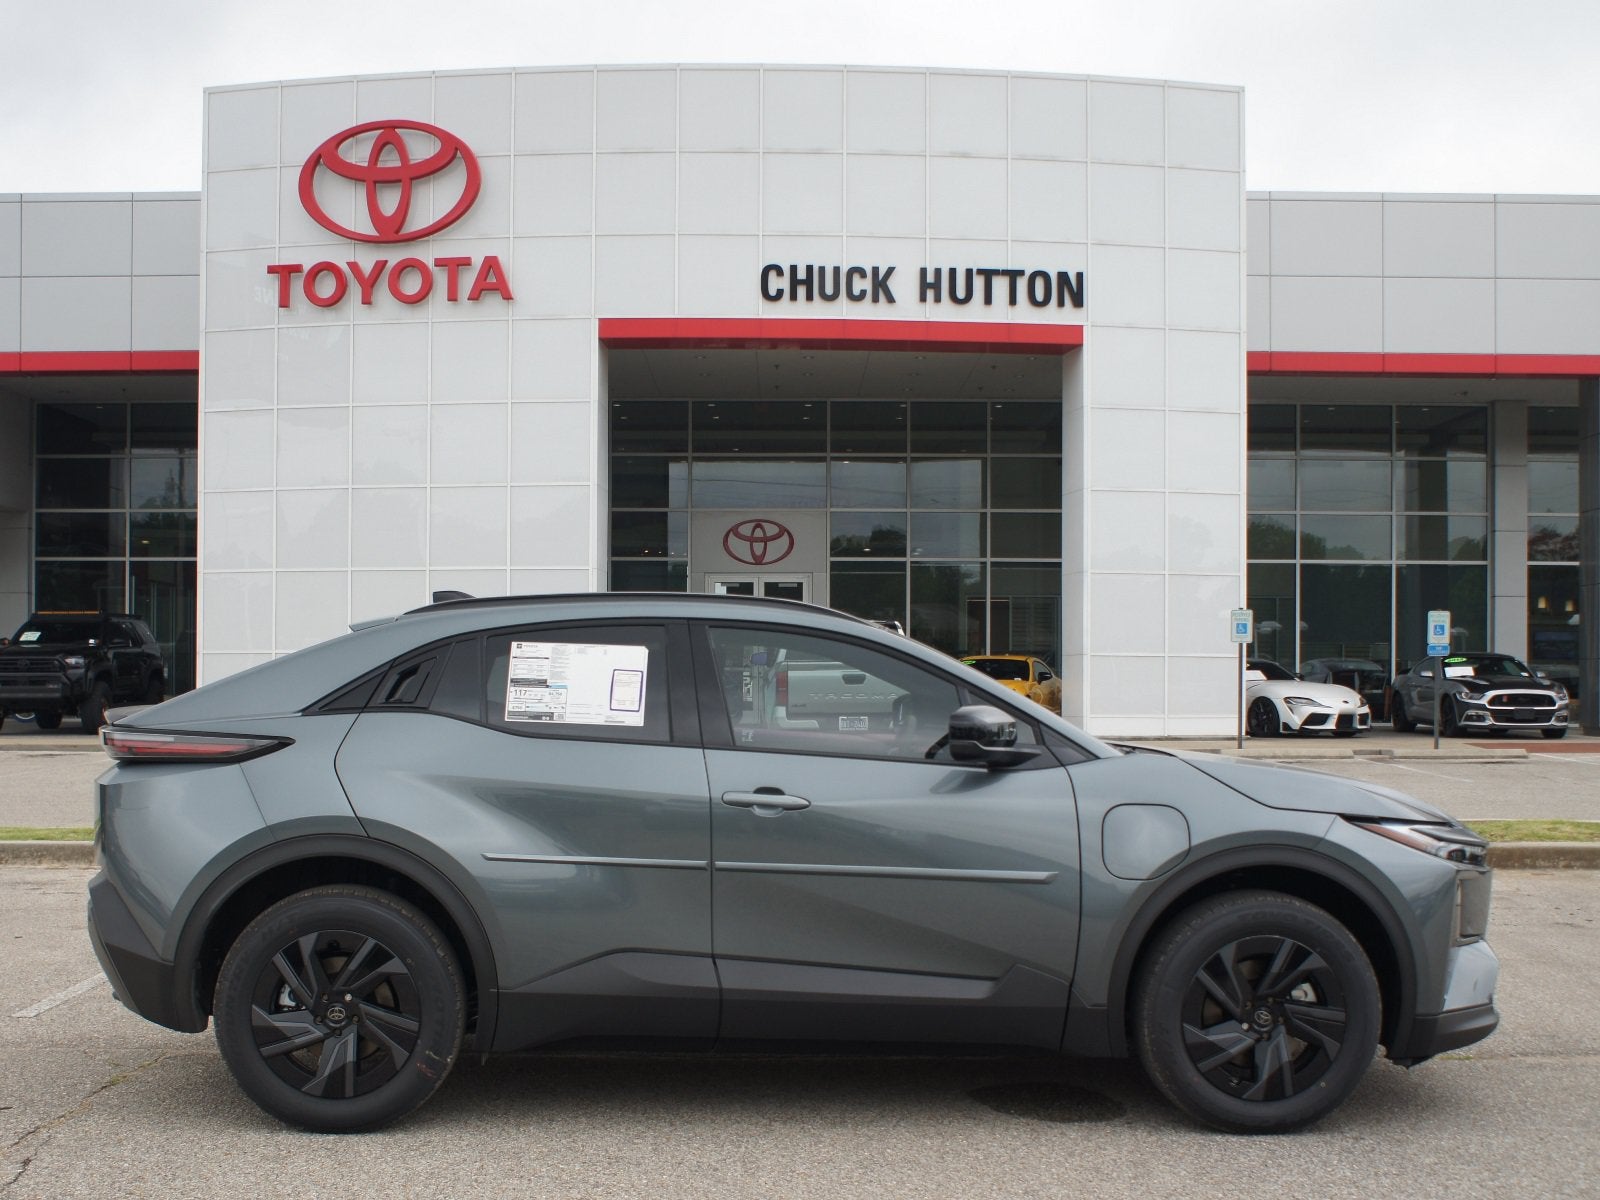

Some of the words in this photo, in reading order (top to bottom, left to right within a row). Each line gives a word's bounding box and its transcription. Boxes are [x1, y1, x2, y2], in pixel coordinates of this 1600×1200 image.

[267, 255, 514, 308] TOYOTA
[760, 263, 897, 304] CHUCK
[919, 266, 1085, 308] HUTTON
